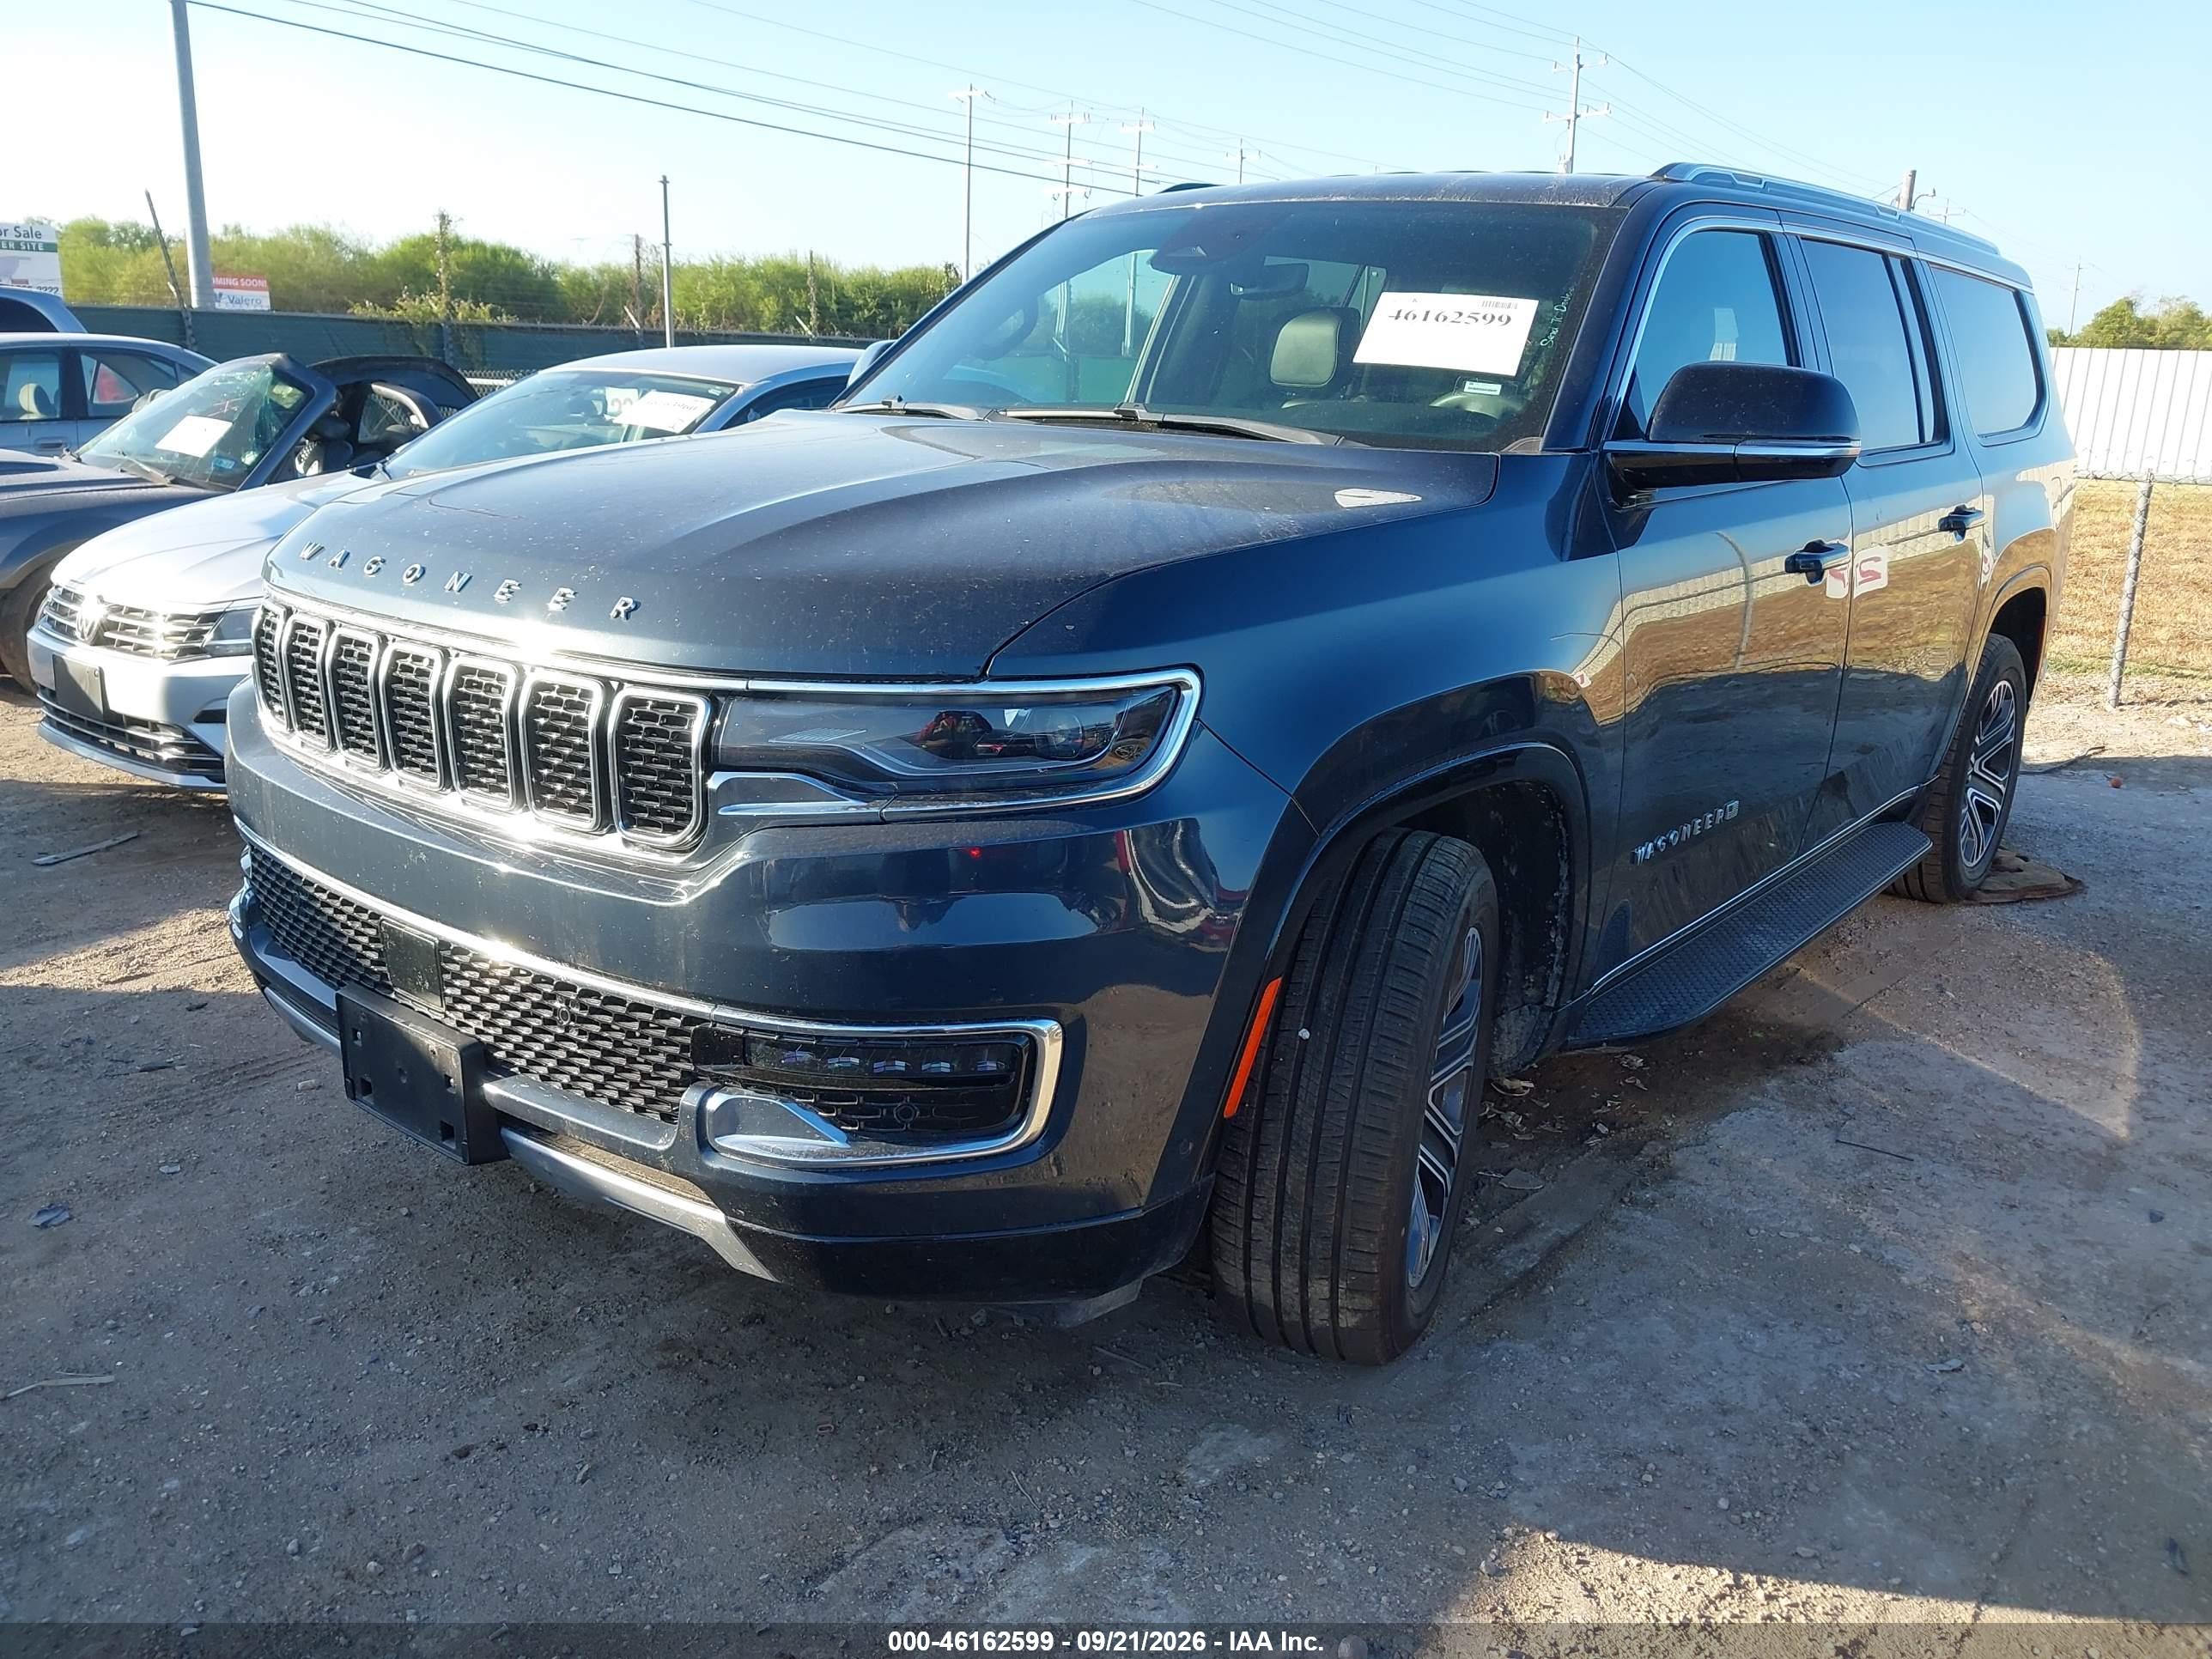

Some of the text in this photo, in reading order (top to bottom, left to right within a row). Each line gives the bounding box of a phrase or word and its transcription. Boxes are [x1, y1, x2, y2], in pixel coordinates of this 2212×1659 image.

[14, 226, 41, 239] Sale
[21, 241, 44, 251] SITE
[212, 276, 239, 286] MING
[1388, 309, 1512, 326] 46162599
[300, 542, 640, 620] WAGONEER
[1631, 808, 1724, 866] WAGONEER
